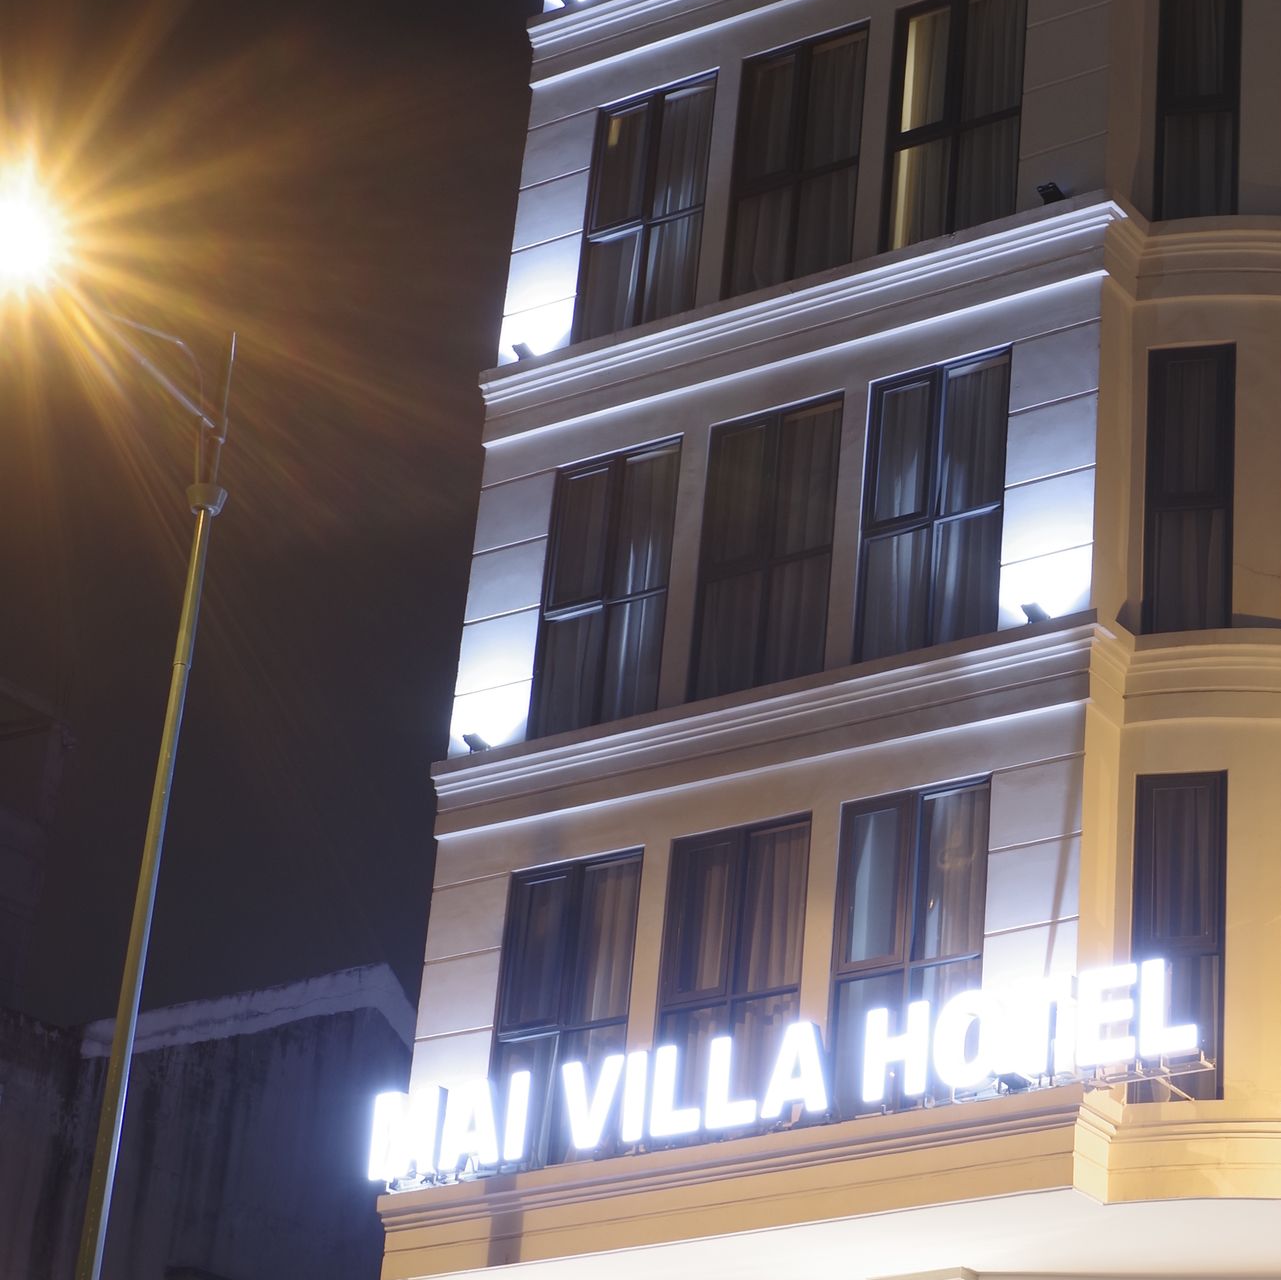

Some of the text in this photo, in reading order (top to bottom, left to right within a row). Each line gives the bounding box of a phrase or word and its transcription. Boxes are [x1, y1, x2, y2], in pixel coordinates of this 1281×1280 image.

[368, 958, 1198, 1181] MAI VILLA HOTEL
